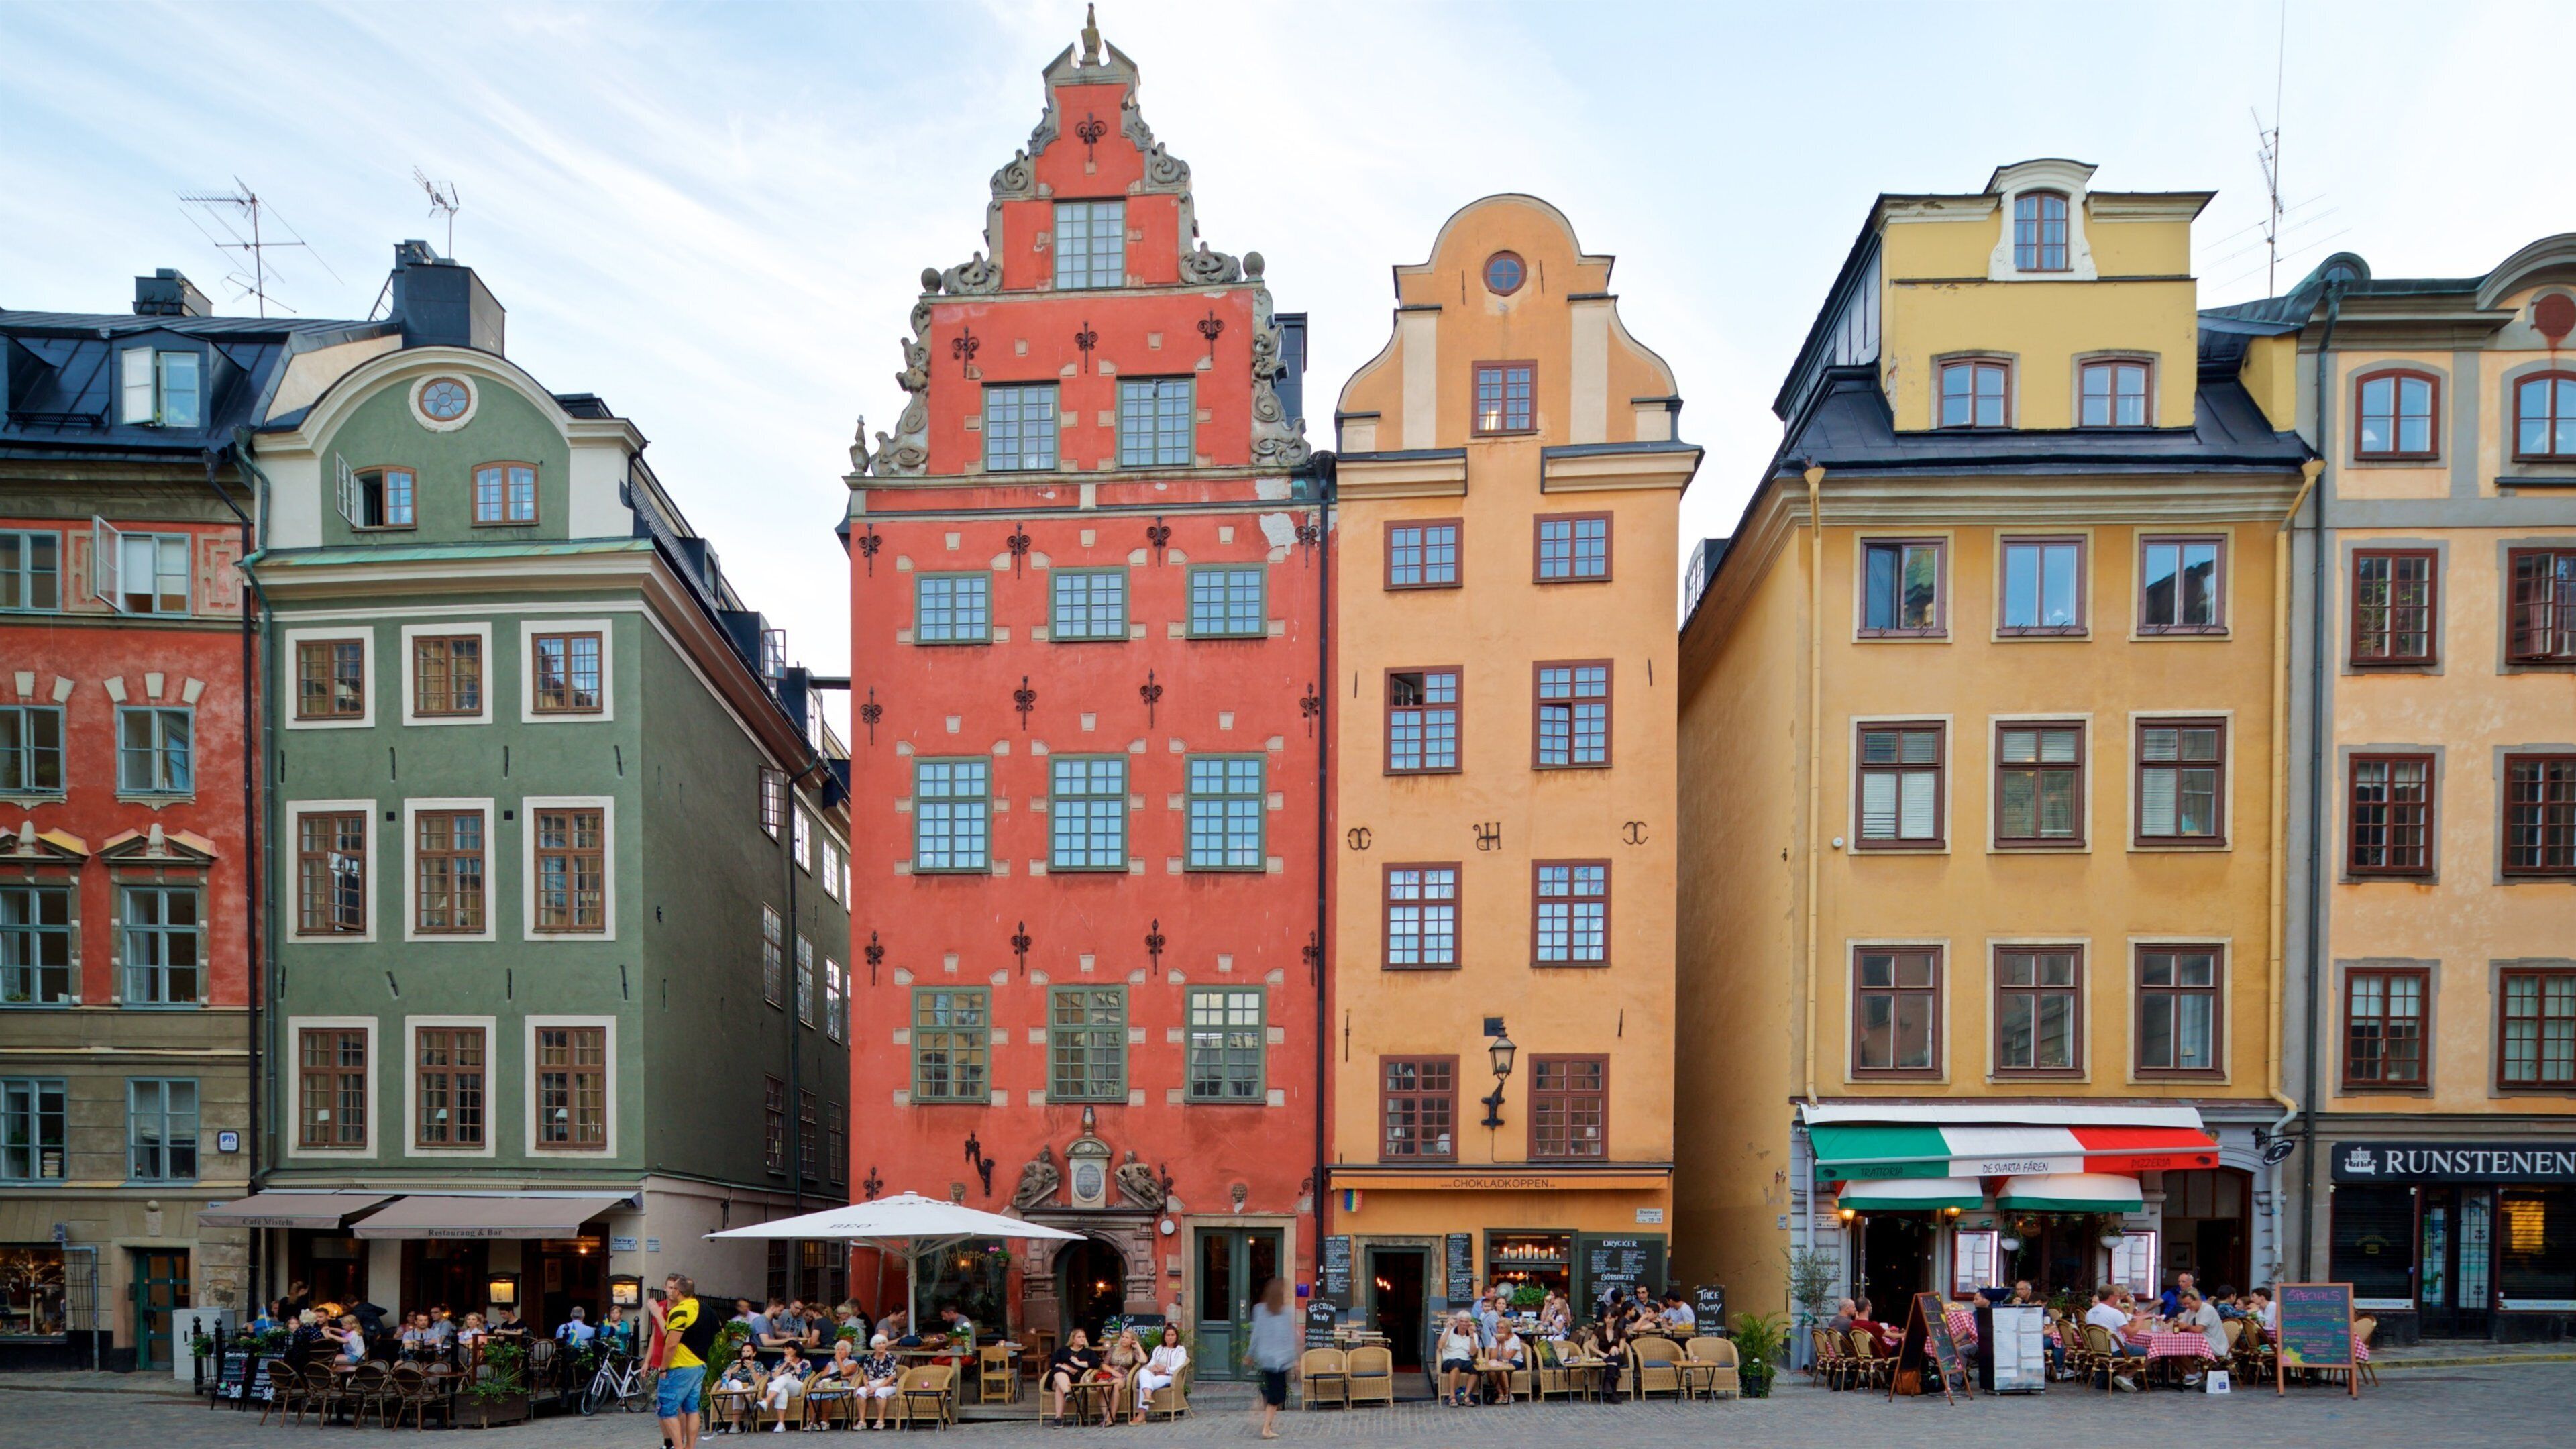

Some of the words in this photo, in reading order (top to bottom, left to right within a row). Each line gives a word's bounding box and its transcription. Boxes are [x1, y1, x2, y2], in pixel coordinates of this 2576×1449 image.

[1982, 1163, 1993, 1174] DE
[1994, 1162, 2021, 1173] SVARTA
[2023, 1160, 2049, 1173] FÅREN
[2131, 1157, 2171, 1169] PIZZERIA
[2384, 1150, 2576, 1175] RUNSTENEN
[1860, 1166, 1904, 1177] TRATTORIA
[242, 1218, 262, 1226] Café
[264, 1218, 294, 1226] Misteln
[429, 1229, 476, 1238] Restaurang
[1603, 1240, 1638, 1248] DRYCKER
[1697, 1289, 1720, 1301] TAKE
[2286, 1289, 2341, 1301] SPECIALS
[1308, 1303, 1319, 1314] ICE
[1318, 1303, 1336, 1313] CREAM
